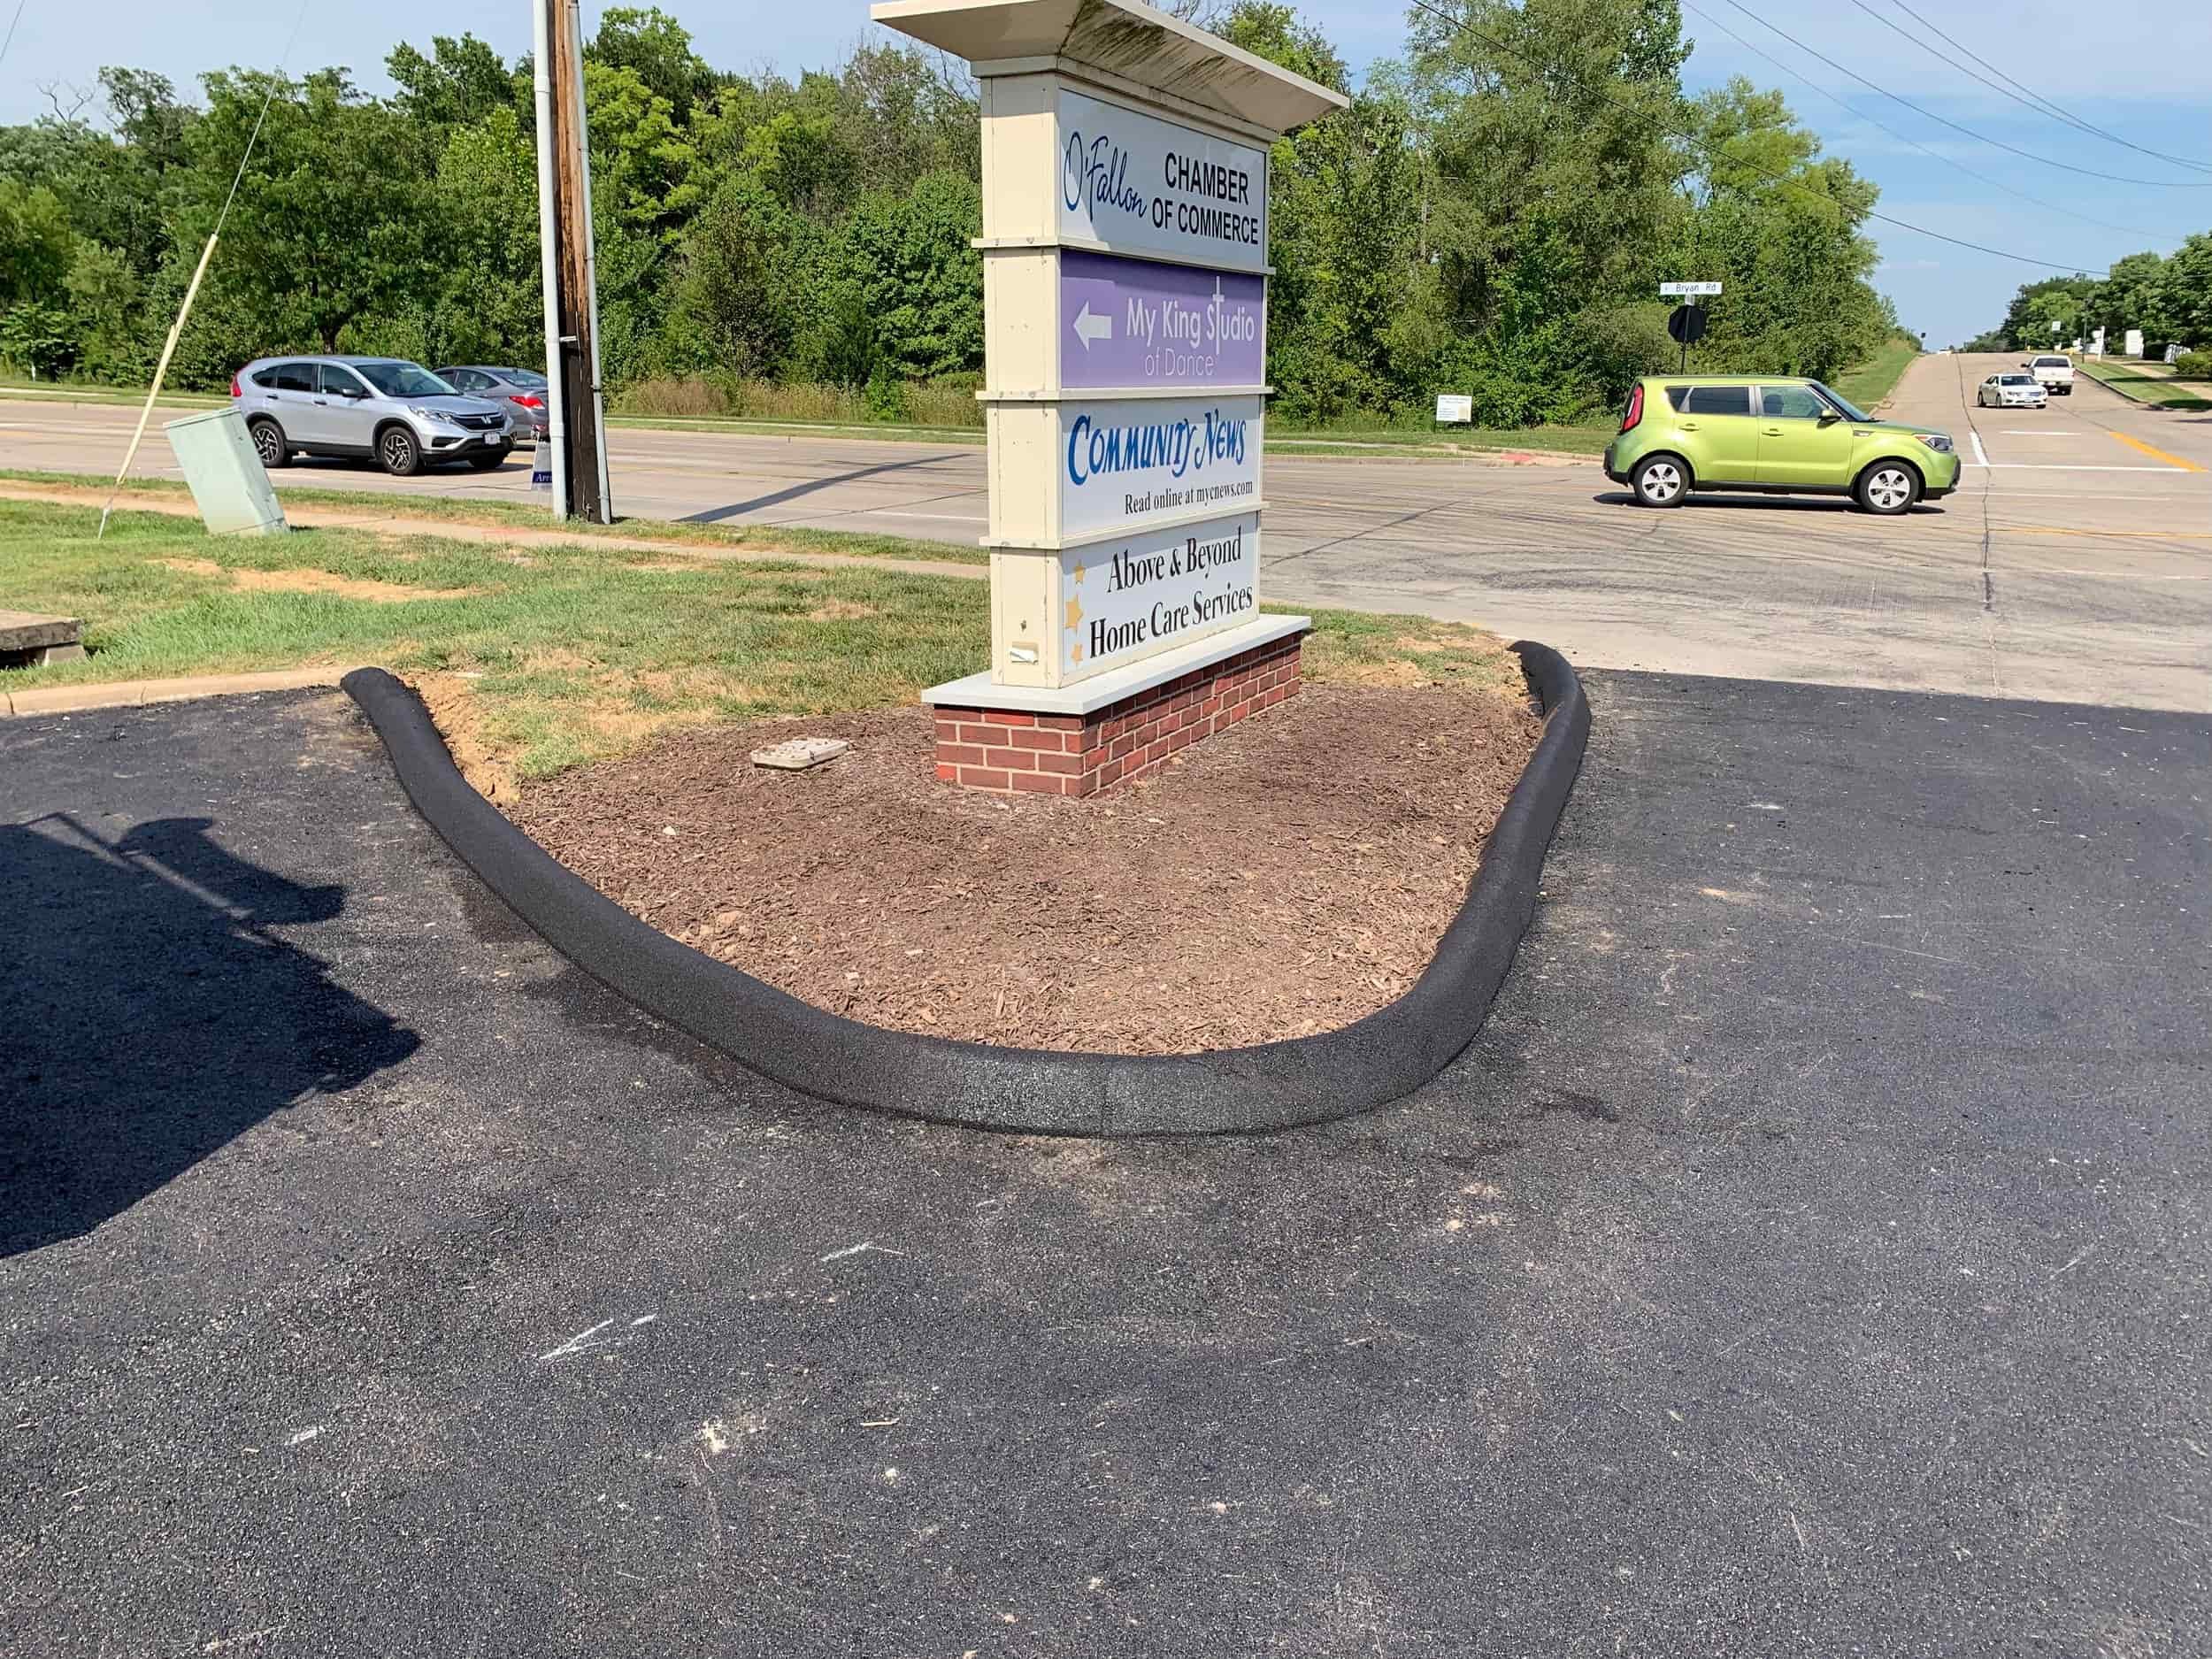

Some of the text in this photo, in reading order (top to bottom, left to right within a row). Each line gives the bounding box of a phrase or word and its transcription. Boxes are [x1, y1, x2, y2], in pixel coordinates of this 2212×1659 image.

[1064, 131, 1147, 222] O'Fallon
[1164, 152, 1249, 205] CHAMBER
[1152, 197, 1258, 245] OF COMMERCE
[1126, 276, 1255, 354] My King Studio
[1676, 284, 1699, 293] Bryan
[1145, 347, 1214, 376] of Dance
[1125, 480, 1253, 515] Read online at mycnews.com
[1107, 524, 1241, 593] Above & Beyond
[1090, 581, 1253, 659] Home Care Services
